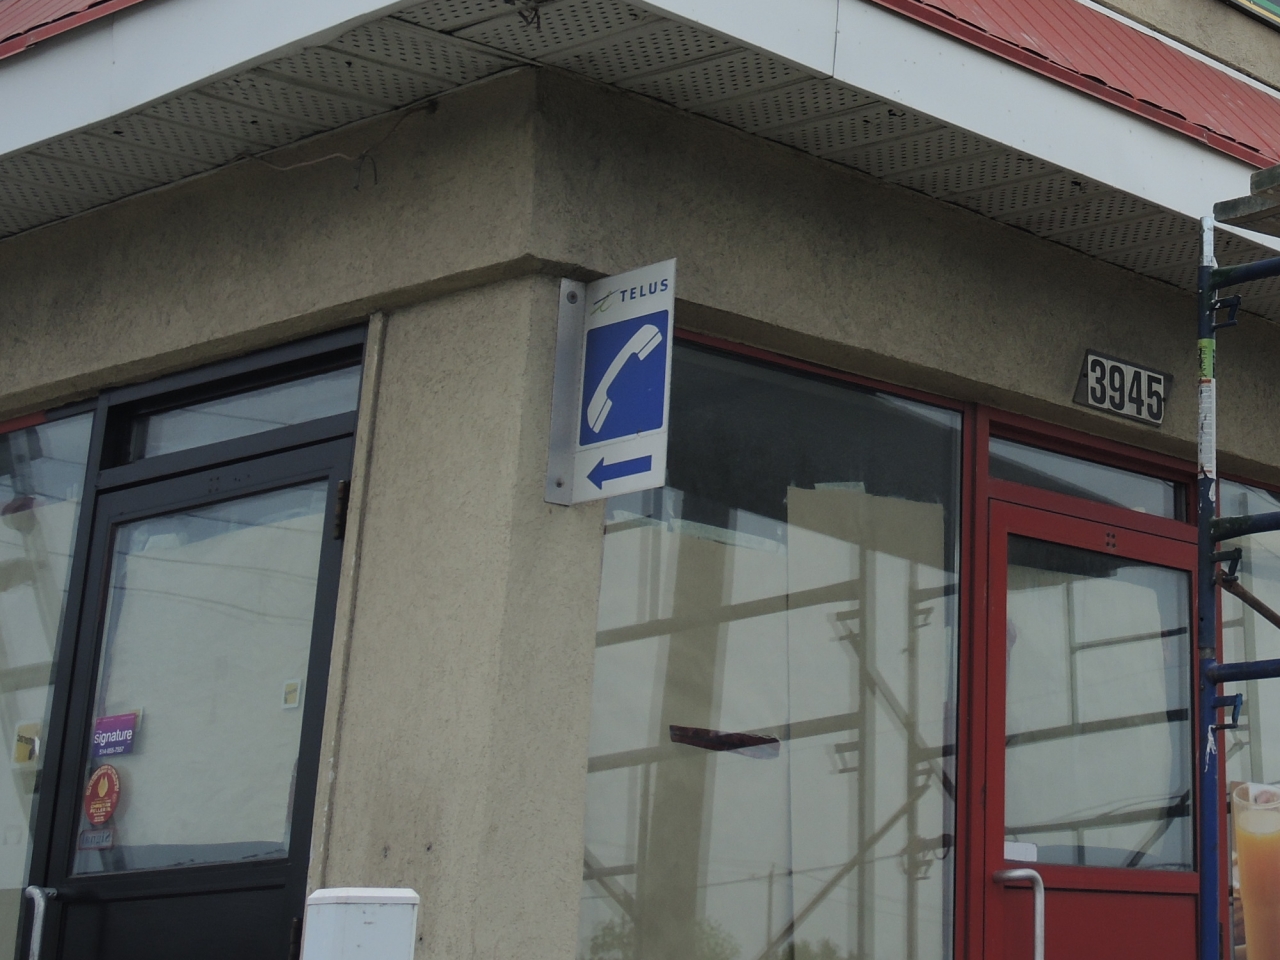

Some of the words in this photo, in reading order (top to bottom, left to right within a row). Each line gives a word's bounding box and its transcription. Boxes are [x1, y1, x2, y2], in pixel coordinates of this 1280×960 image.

[619, 278, 669, 303] TELUS
[1090, 358, 1163, 421] 3945
[94, 728, 133, 746] signature
